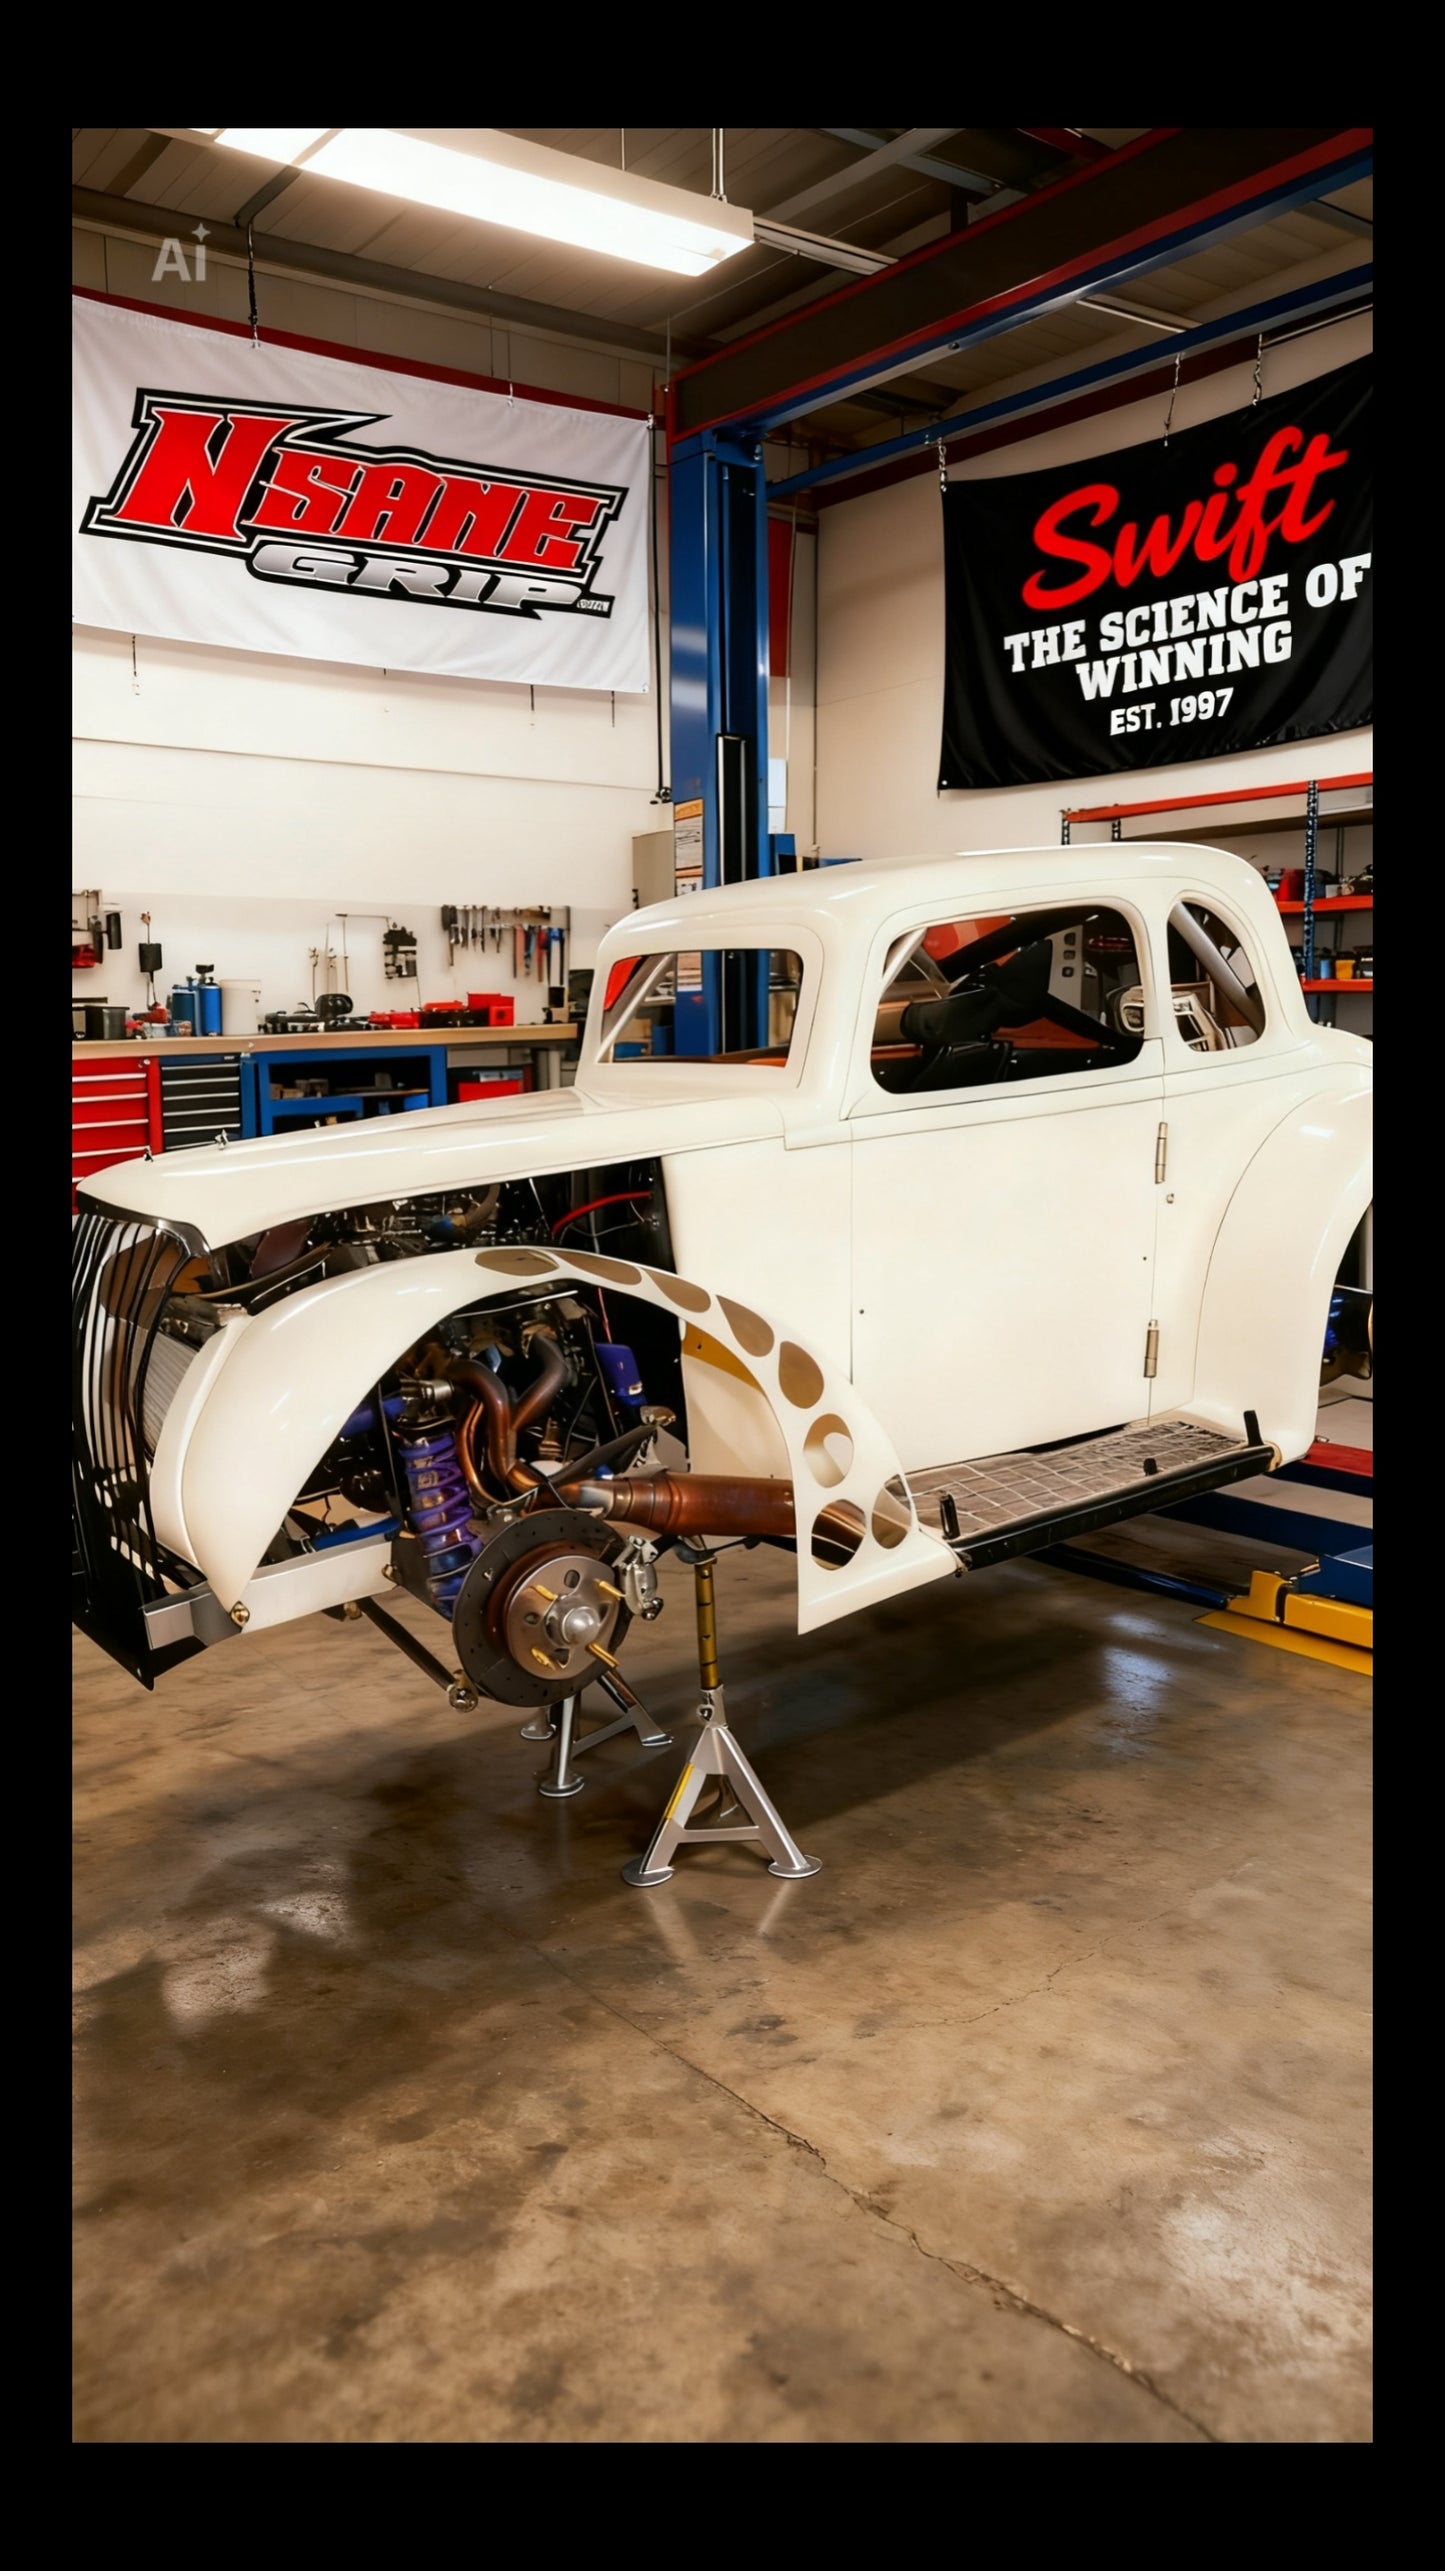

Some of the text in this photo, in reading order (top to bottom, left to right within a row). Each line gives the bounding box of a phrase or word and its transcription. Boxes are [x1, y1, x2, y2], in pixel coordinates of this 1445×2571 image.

[1021, 425, 1348, 610] Swift
[252, 543, 583, 610] GRIP
[1003, 552, 1372, 674] THE SCIENCE OF
[1075, 620, 1293, 701] WINNING
[1109, 687, 1234, 736] EST. 1997
